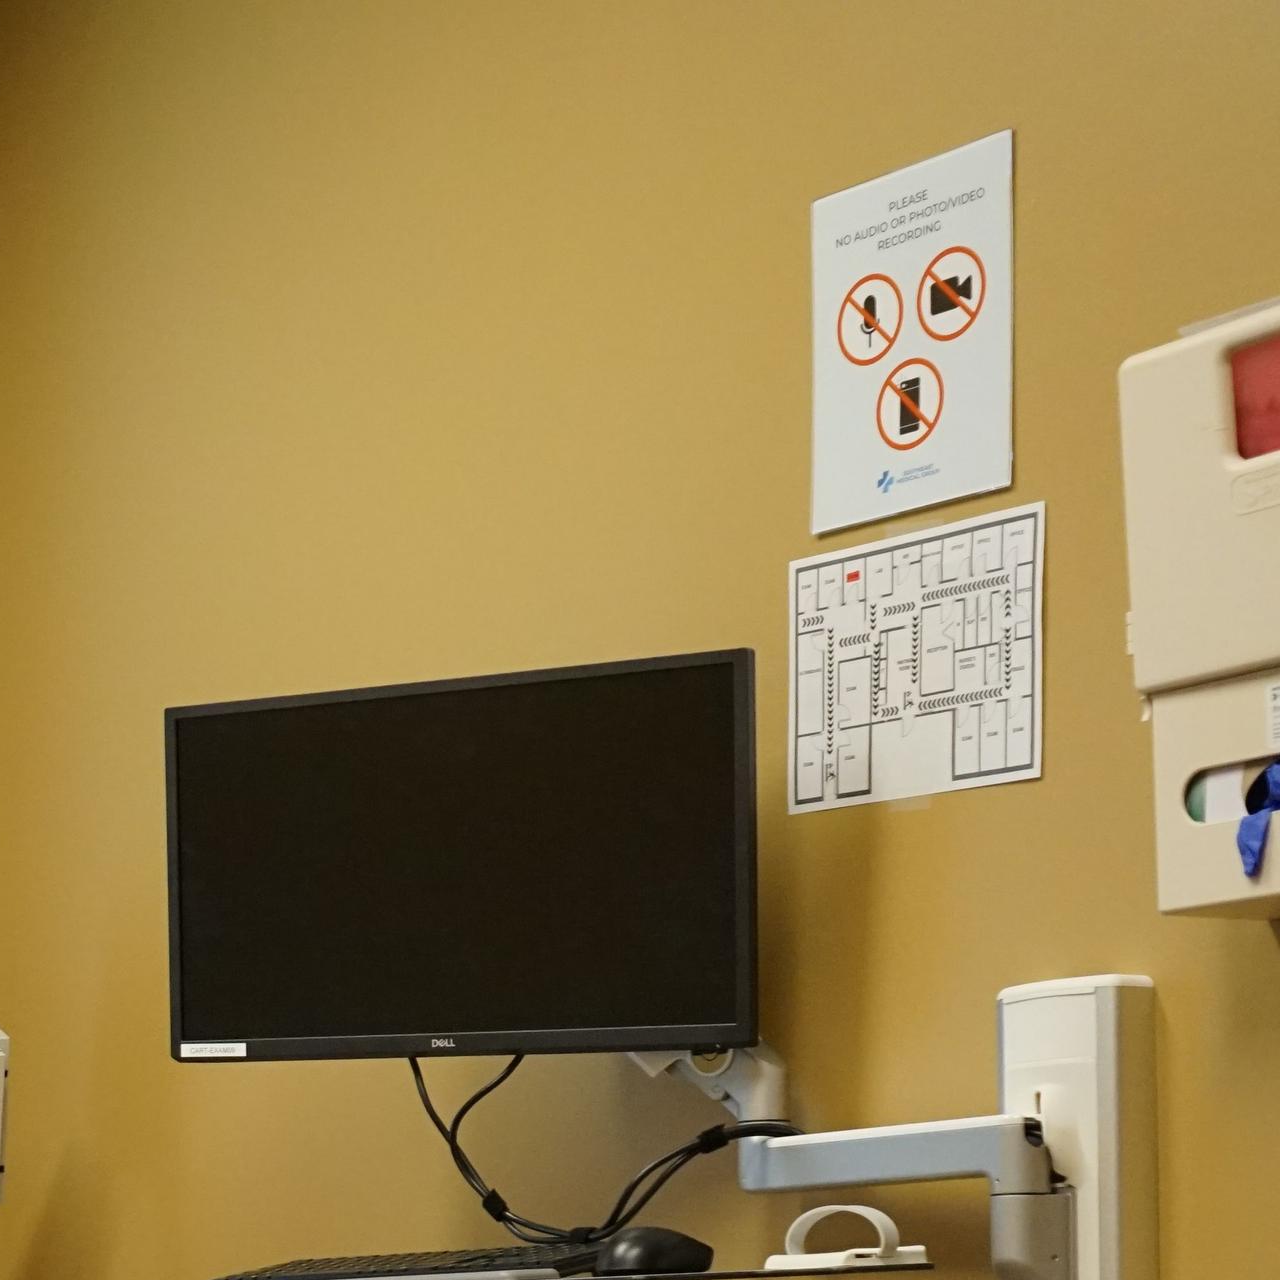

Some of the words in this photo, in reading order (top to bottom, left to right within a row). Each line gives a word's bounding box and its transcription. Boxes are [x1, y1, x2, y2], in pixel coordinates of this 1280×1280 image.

[888, 189, 929, 212] PLEASE
[835, 234, 852, 249] NO
[853, 221, 888, 243] AUDIO
[890, 215, 906, 230] OR
[909, 187, 986, 222] PHOTO/VIDEO
[877, 220, 942, 251] RECORDING
[431, 1038, 456, 1048] DELL
